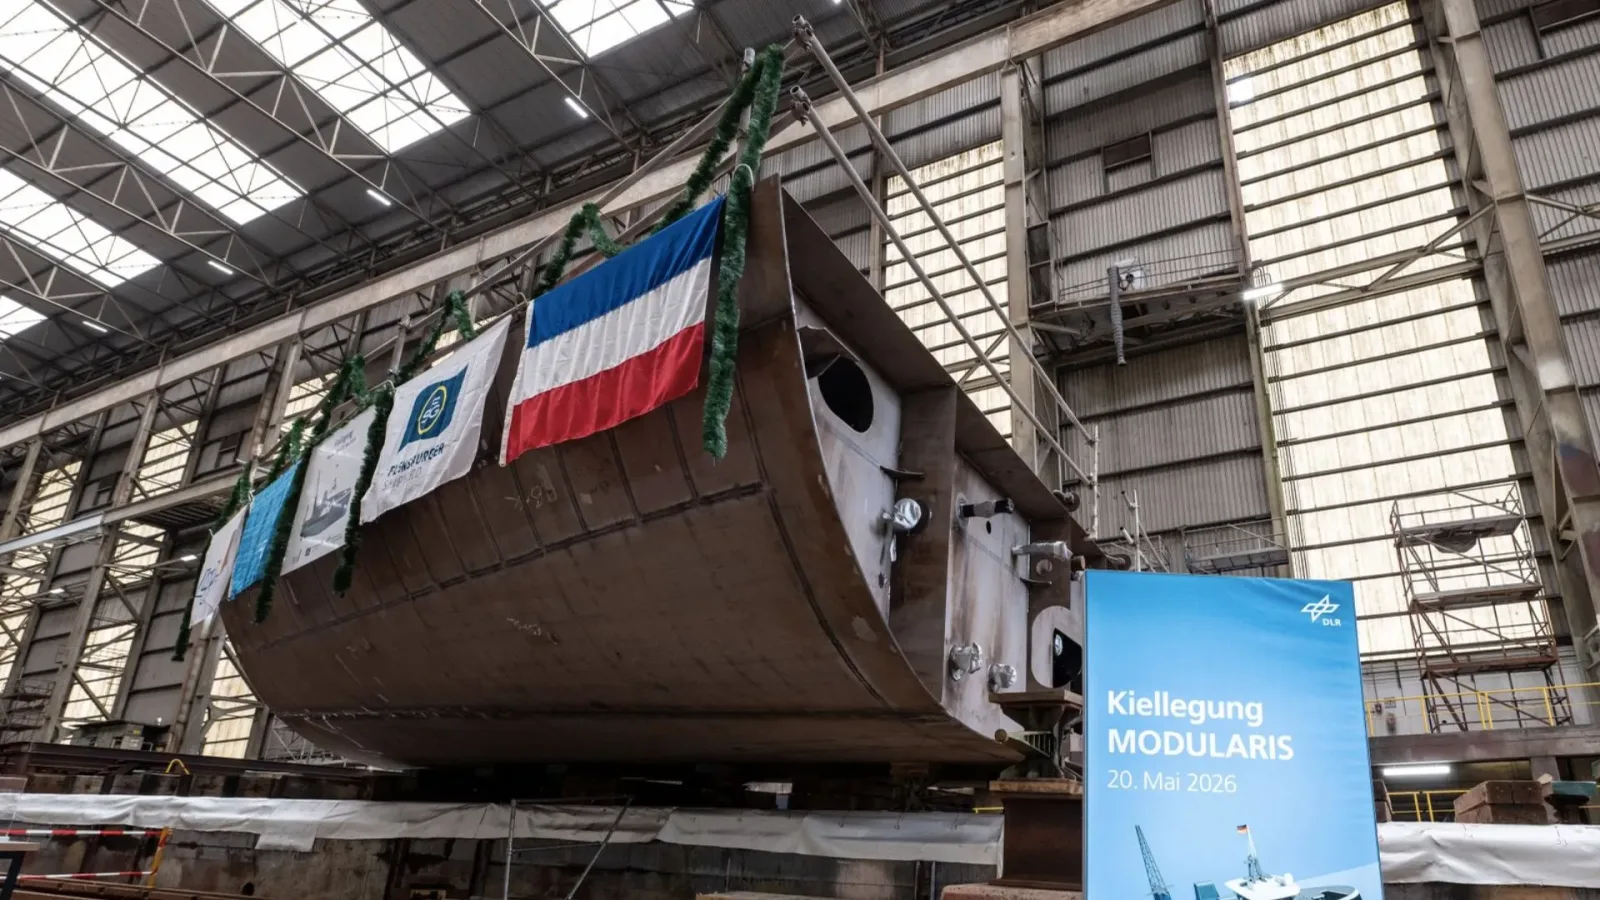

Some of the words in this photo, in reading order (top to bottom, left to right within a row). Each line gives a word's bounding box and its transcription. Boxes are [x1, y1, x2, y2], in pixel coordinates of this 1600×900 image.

[1322, 617, 1342, 627] DLR
[1107, 690, 1264, 727] Kiellegung
[1108, 728, 1294, 761] MODULARIS
[1106, 769, 1138, 790] 20.
[1143, 771, 1180, 791] Mai
[1186, 773, 1237, 793] 2026
